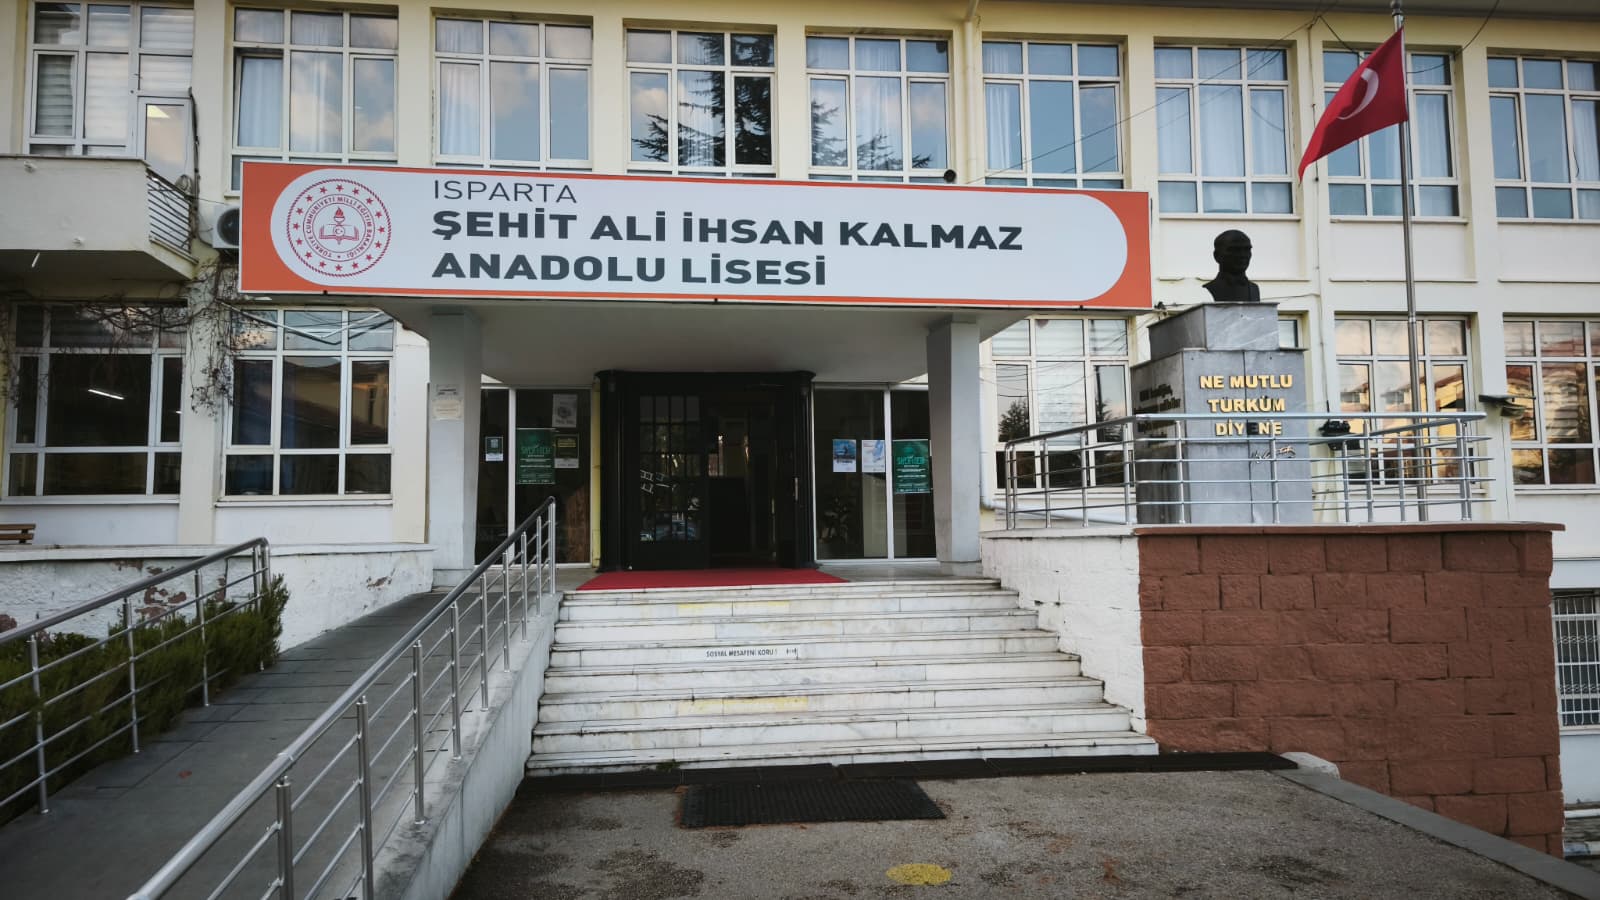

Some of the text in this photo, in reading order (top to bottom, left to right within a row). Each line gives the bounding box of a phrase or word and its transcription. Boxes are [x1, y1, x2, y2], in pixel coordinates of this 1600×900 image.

[434, 179, 577, 203] ISPARTA
[432, 208, 1024, 251] ŞEHİT ALİ İHSAN KALMAZ
[431, 253, 826, 286] ANADOLU LİSESİ
[1199, 374, 1294, 389] NE MUTLU
[1207, 396, 1285, 412] TÜRKÜM
